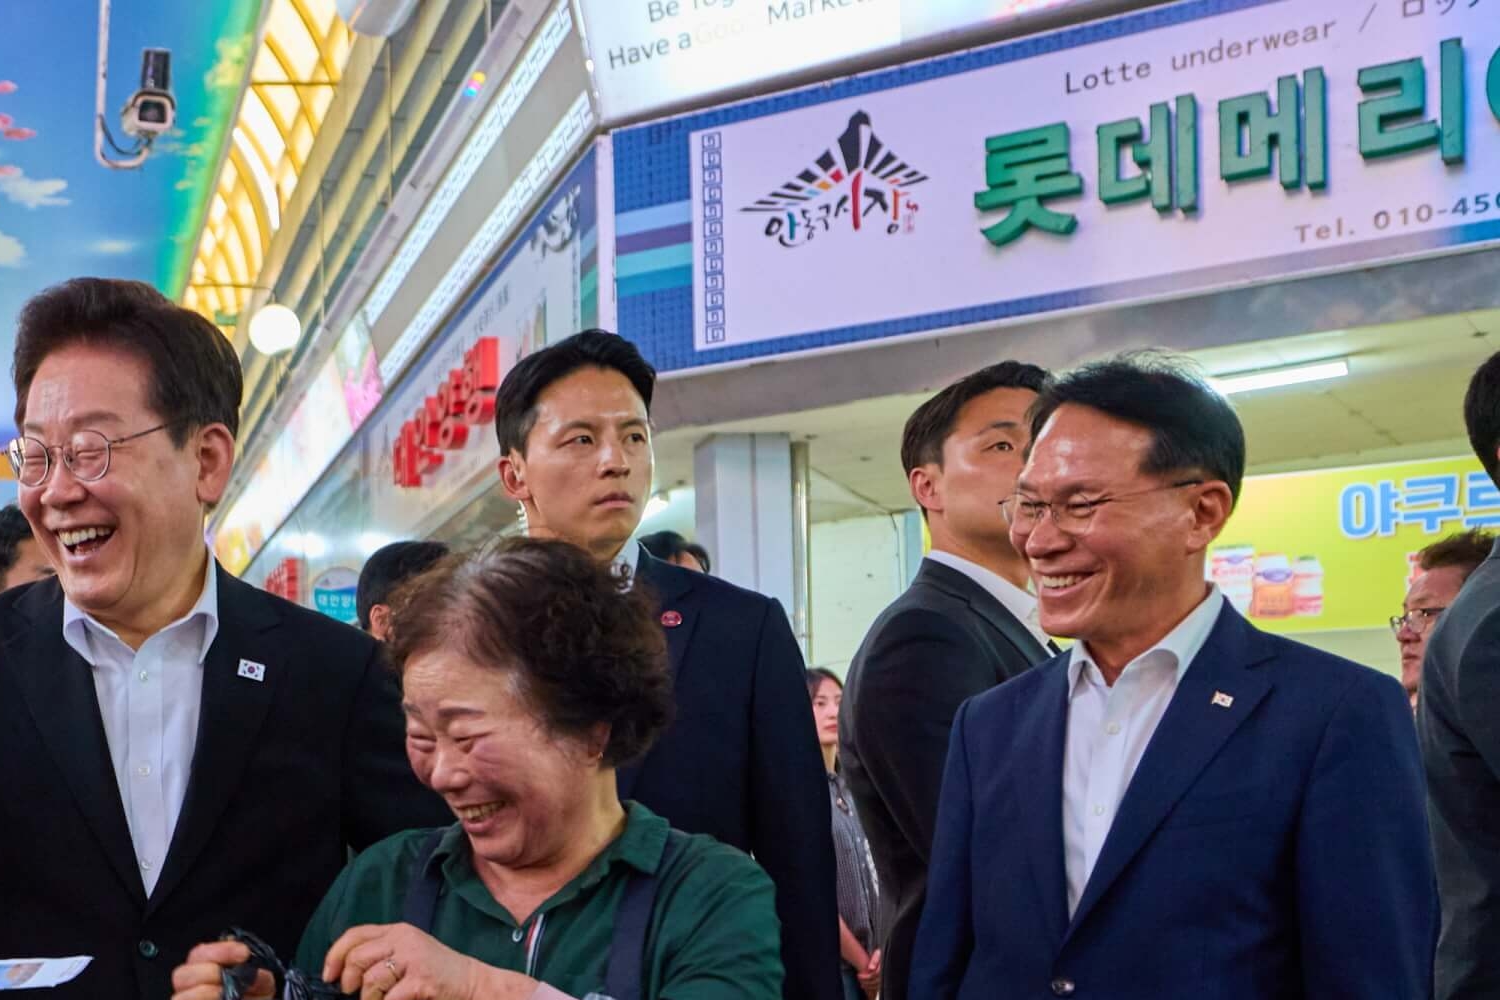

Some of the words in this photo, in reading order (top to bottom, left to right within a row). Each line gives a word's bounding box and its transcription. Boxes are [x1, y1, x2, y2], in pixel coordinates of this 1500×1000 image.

[648, 0, 680, 23] Be
[608, 37, 671, 70] Have
[678, 31, 692, 50] a
[1064, 61, 1152, 95] Lotte
[1171, 20, 1337, 72] underwear
[973, 37, 1500, 247] 롯데메리
[1294, 216, 1355, 244] Tel.
[1373, 192, 1500, 231] 010-45
